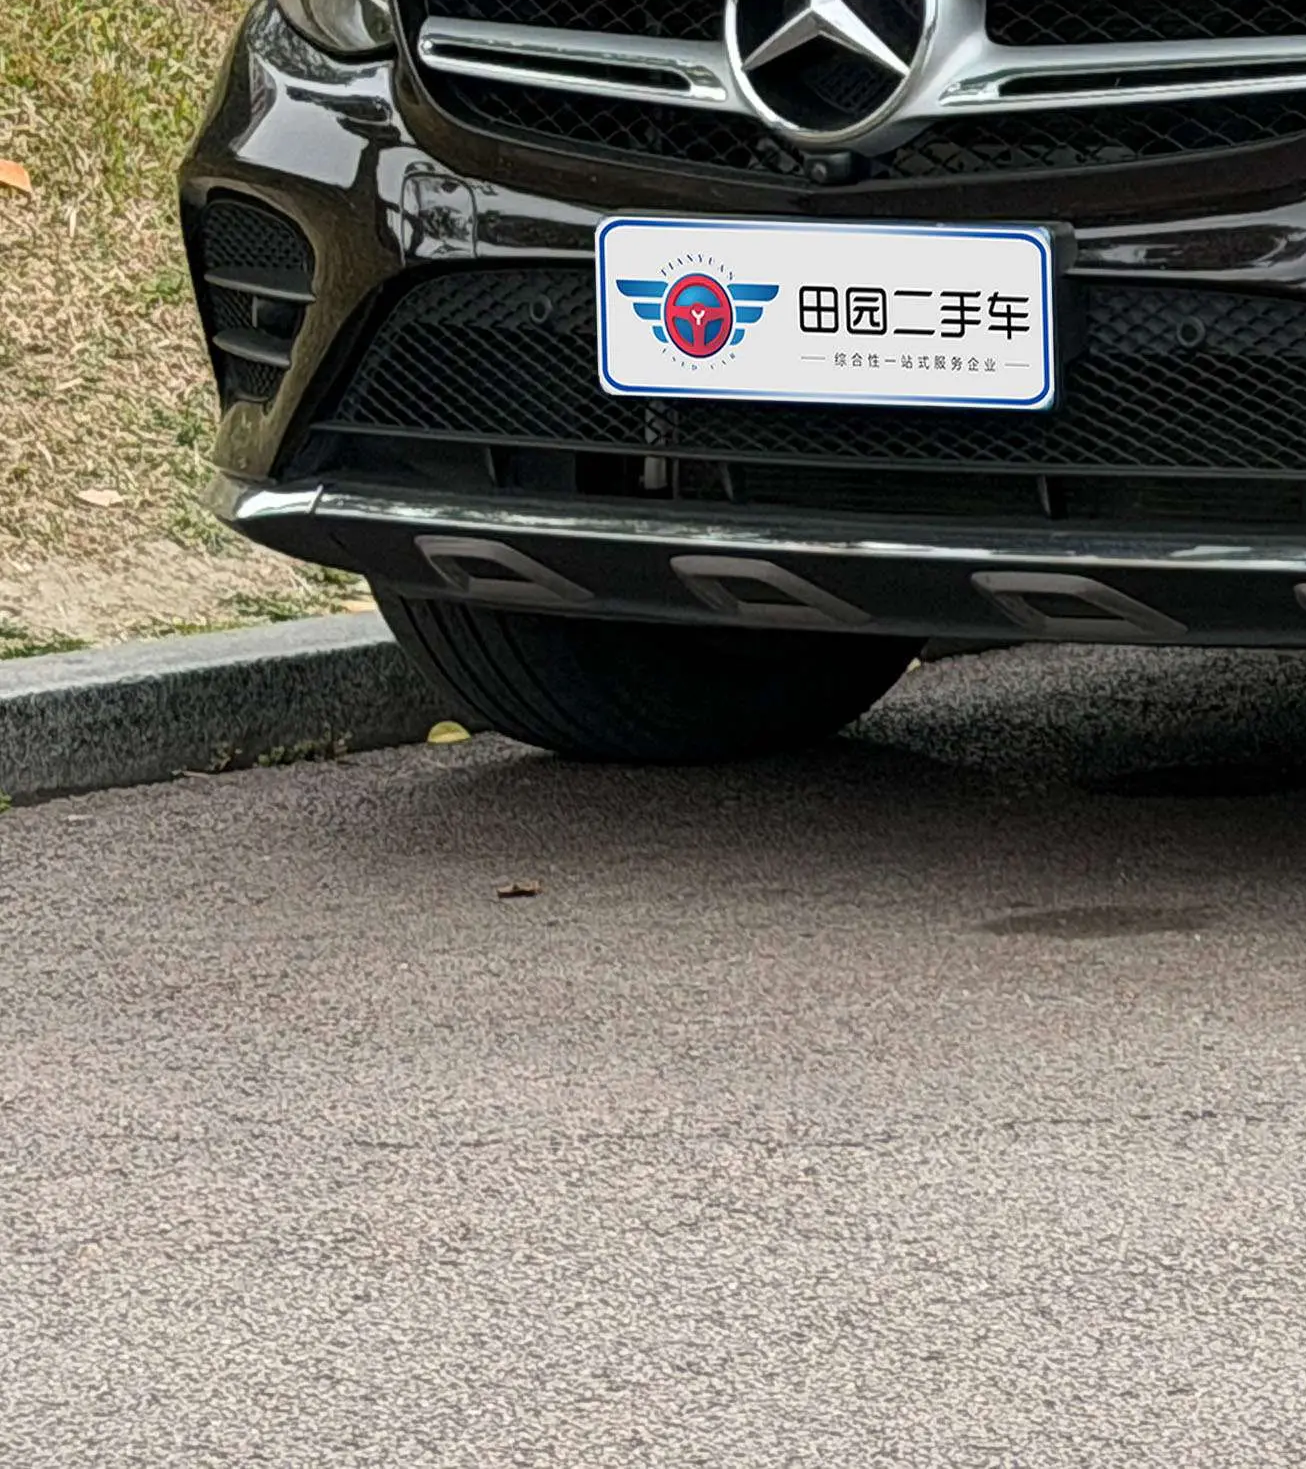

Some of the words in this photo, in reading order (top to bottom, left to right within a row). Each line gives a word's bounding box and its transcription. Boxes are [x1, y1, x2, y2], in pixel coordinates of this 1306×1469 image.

[799, 285, 1031, 340] 田园二手车
[833, 351, 997, 373] 综合性一站式服务企业
